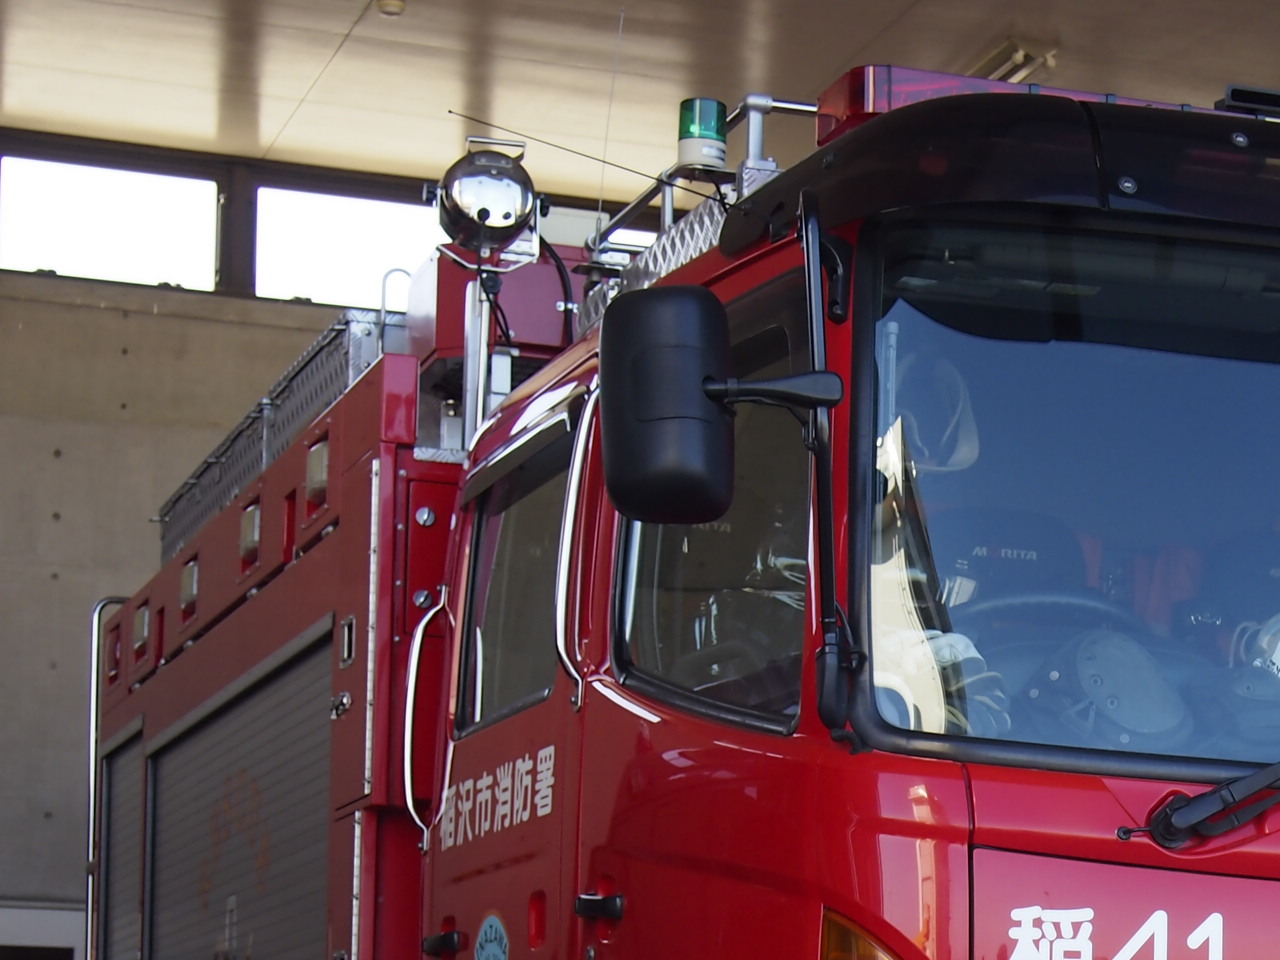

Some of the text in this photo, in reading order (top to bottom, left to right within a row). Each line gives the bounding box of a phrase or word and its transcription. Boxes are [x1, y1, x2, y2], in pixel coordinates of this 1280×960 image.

[441, 744, 556, 852] 稲沢市消防署
